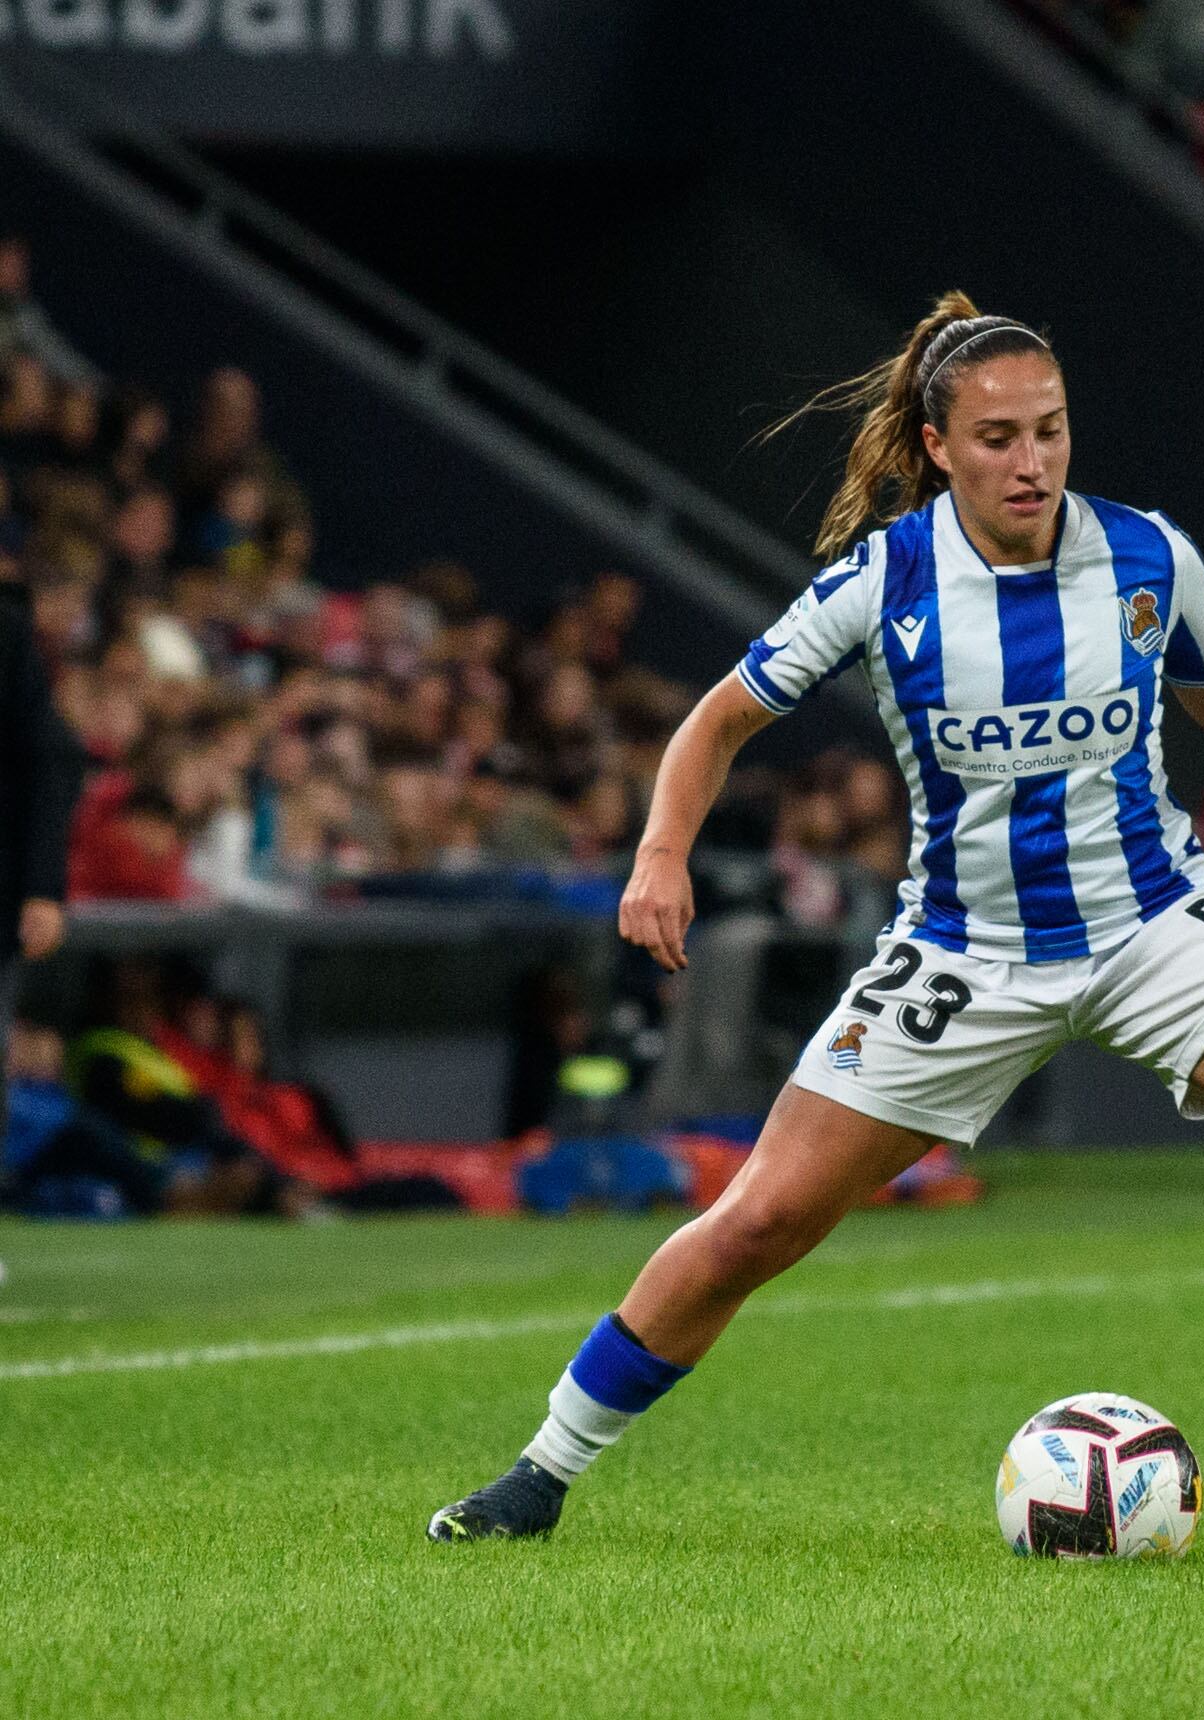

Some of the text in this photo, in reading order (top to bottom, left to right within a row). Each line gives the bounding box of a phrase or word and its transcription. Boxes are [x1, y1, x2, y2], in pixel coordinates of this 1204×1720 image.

[937, 699, 1134, 752] CAZOO
[1012, 752, 1078, 771] Conduce.
[847, 942, 973, 1044] 23
